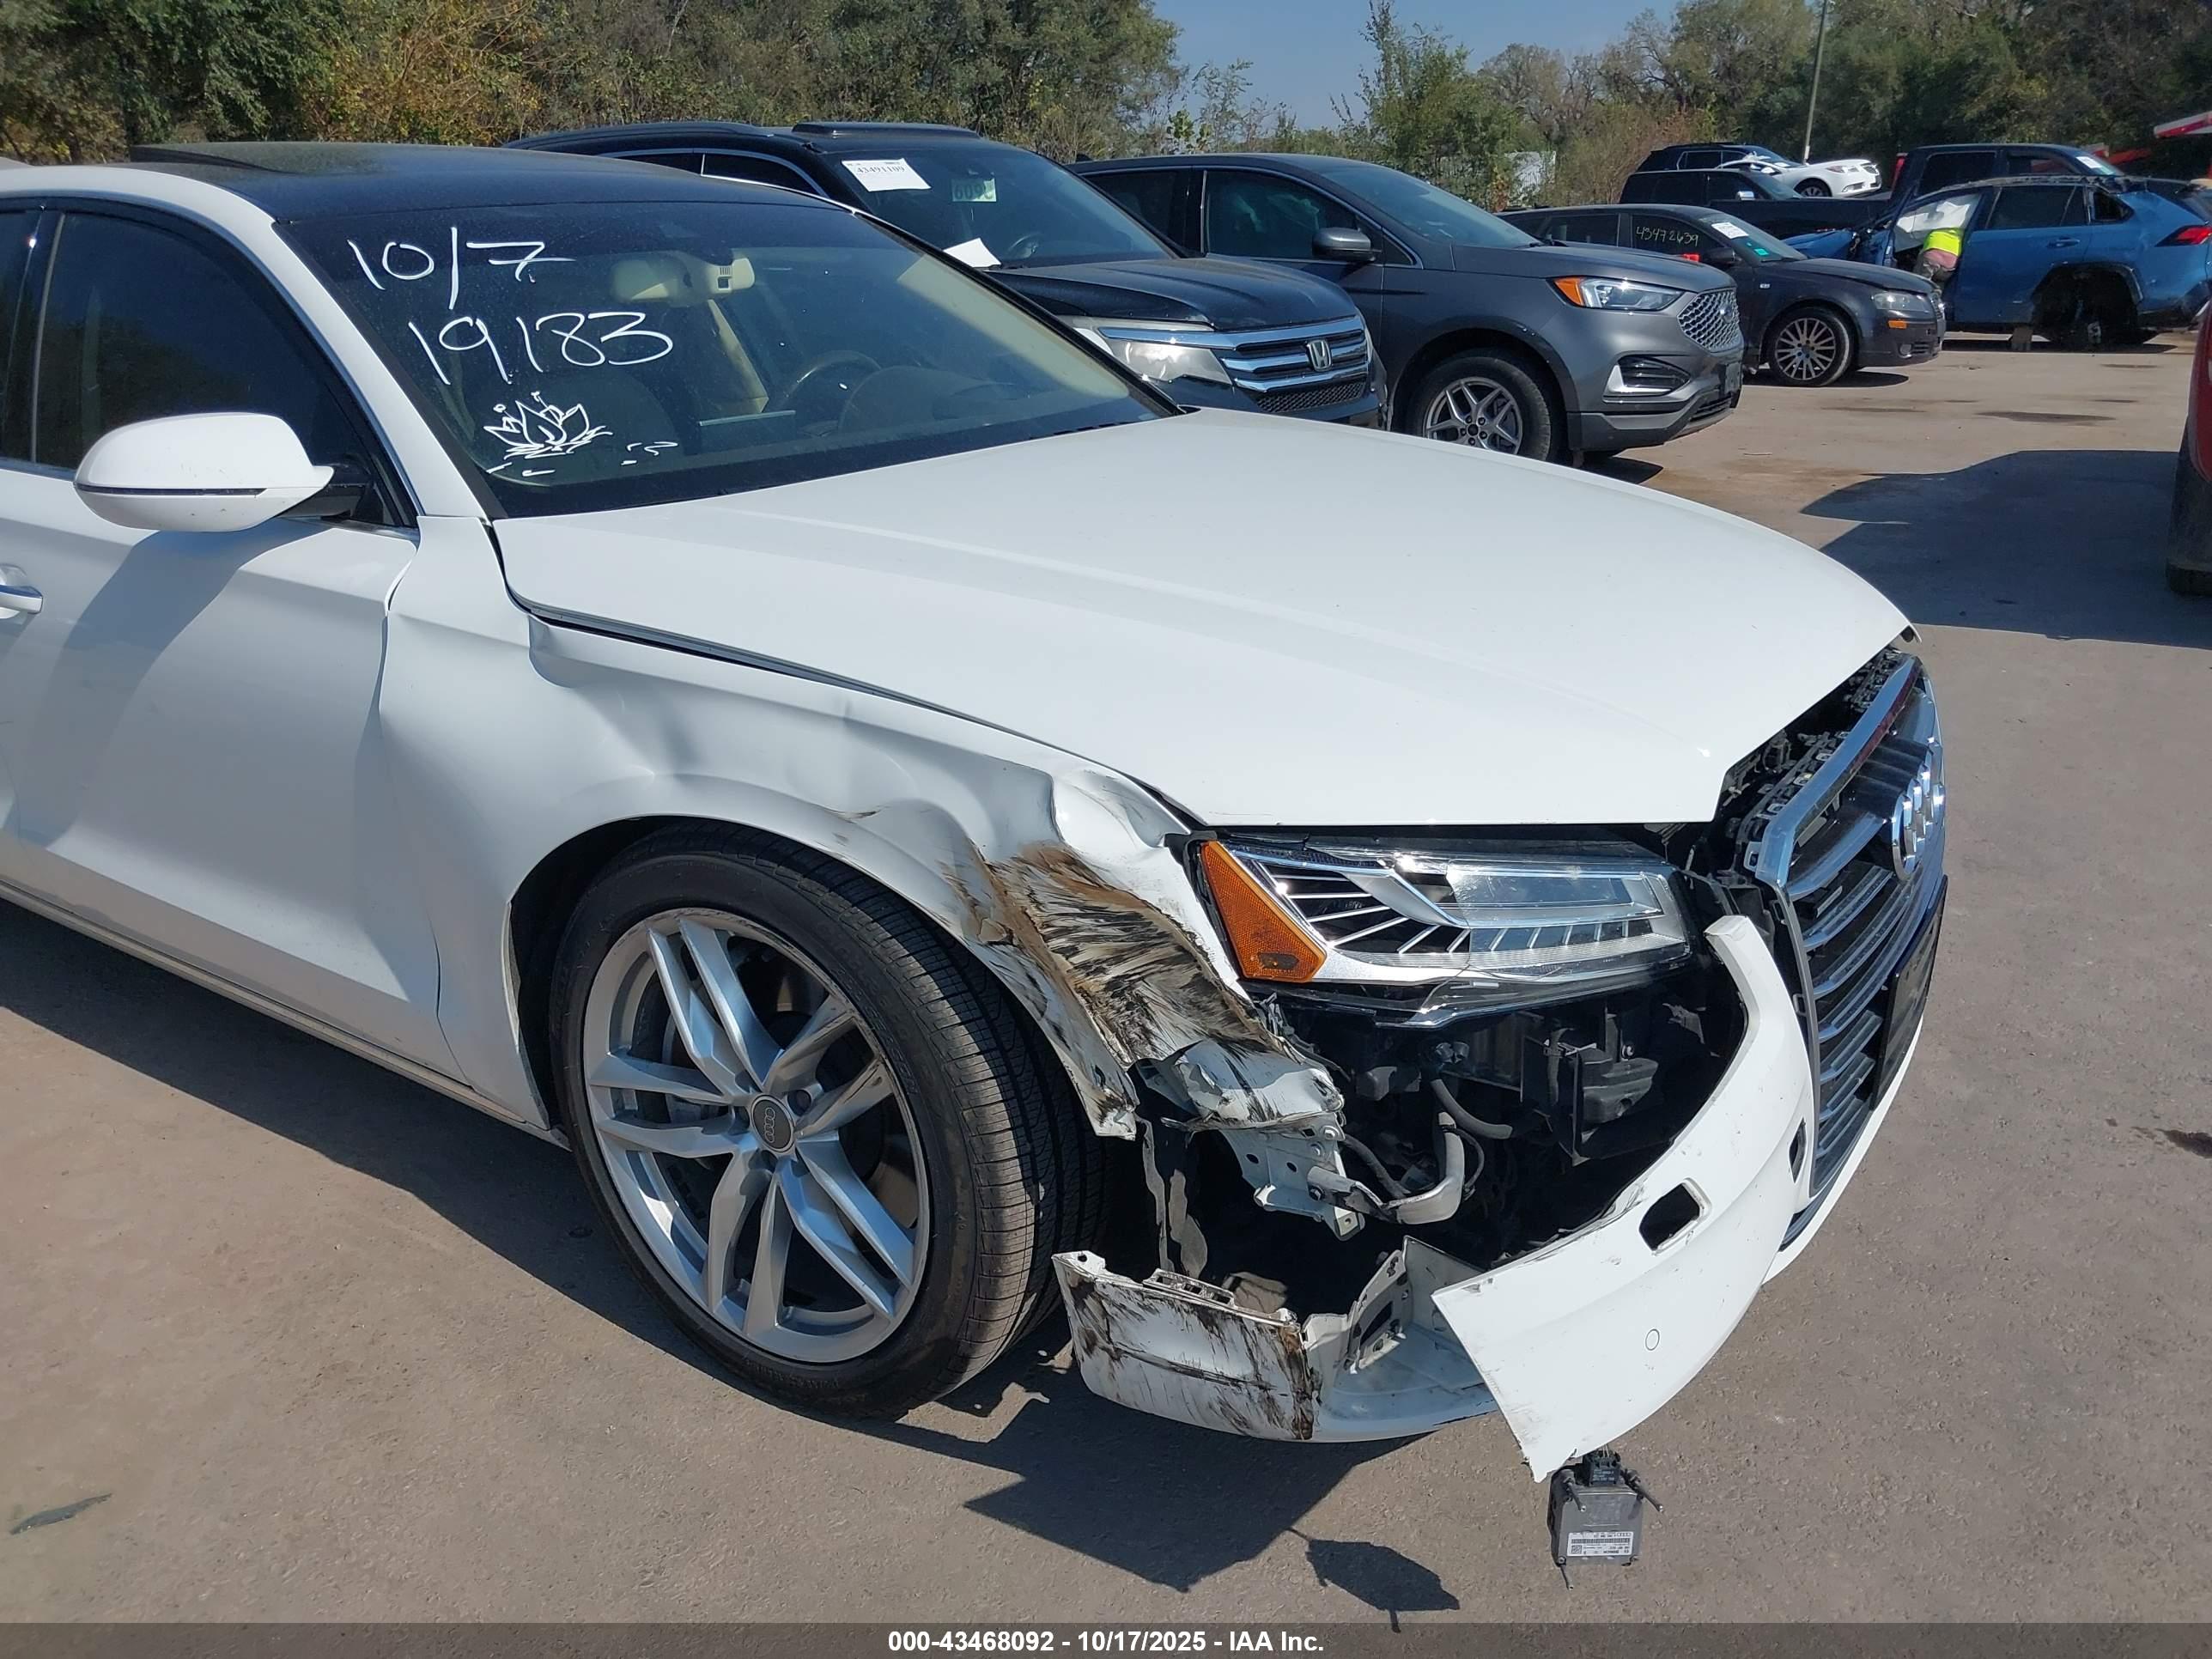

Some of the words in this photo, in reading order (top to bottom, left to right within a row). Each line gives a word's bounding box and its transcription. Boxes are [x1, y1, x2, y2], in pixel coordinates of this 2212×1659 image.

[347, 227, 576, 310] 10/7
[1636, 226, 1698, 246] 43472639
[408, 311, 673, 386] 19183
